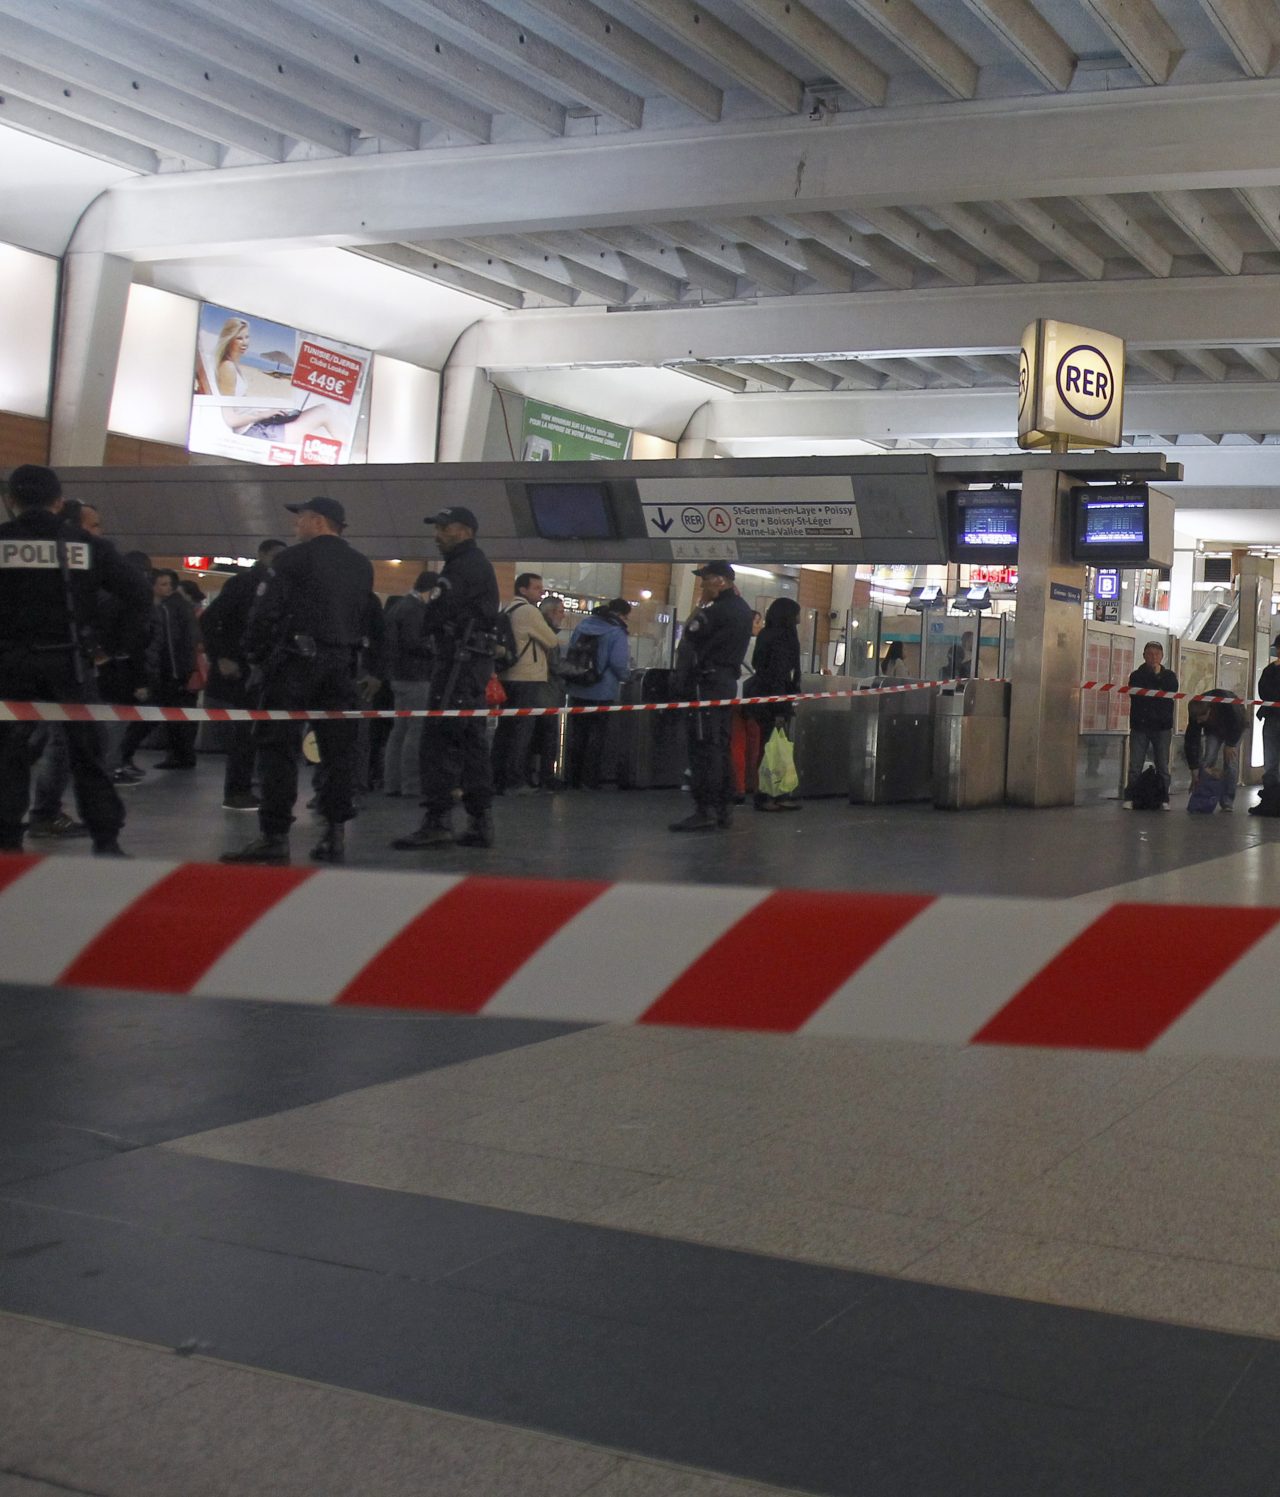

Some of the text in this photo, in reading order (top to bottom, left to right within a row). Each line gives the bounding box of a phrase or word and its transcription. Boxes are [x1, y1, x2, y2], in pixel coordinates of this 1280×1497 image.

[307, 371, 346, 394] 449€
[1066, 365, 1108, 400] RER
[684, 506, 853, 526] RER A St-Germain-en-Laye Poissy
[735, 516, 832, 527] Cergy Boissy-St-Léger
[737, 527, 803, 537] Marne-la-Vallée
[3, 543, 84, 565] POLIE
[1102, 578, 1112, 591] B
